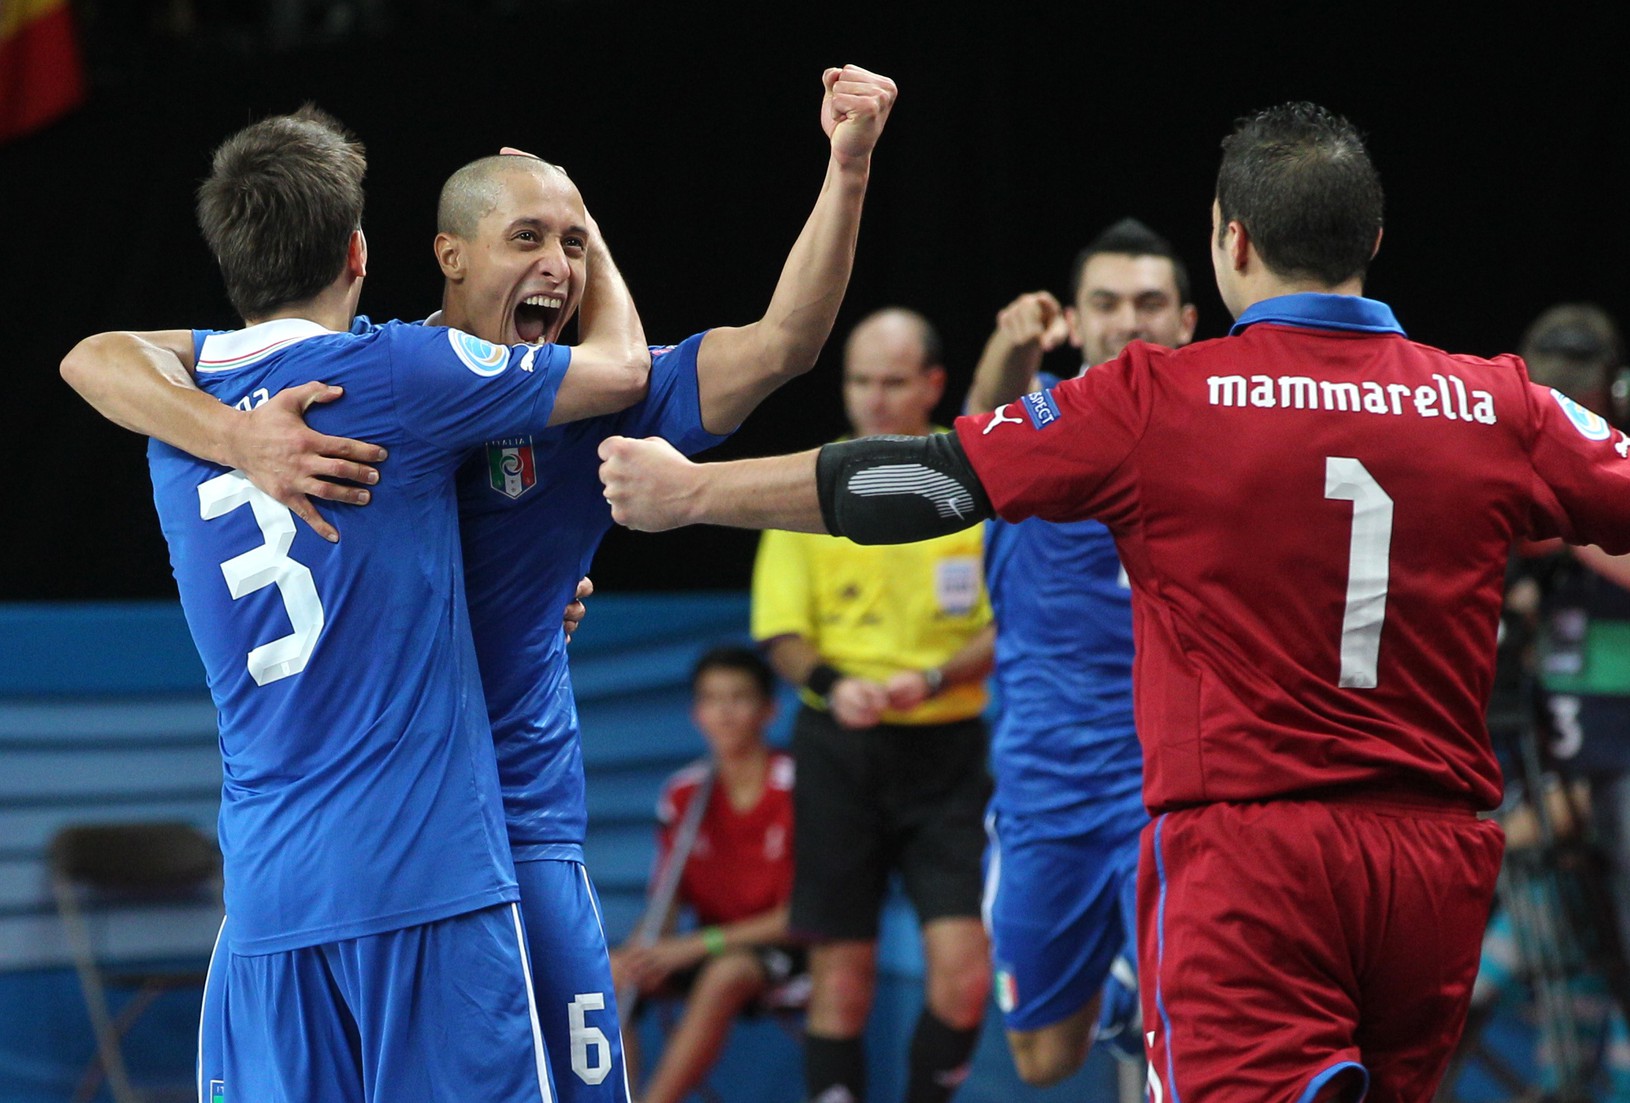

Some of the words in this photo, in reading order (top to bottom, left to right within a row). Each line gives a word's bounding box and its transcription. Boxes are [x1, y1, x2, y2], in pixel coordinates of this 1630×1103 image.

[1028, 391, 1055, 424] SPECT
[1207, 374, 1497, 425] mammarella
[197, 468, 325, 687] 3
[1324, 456, 1394, 689] 1
[567, 992, 612, 1086] 6
